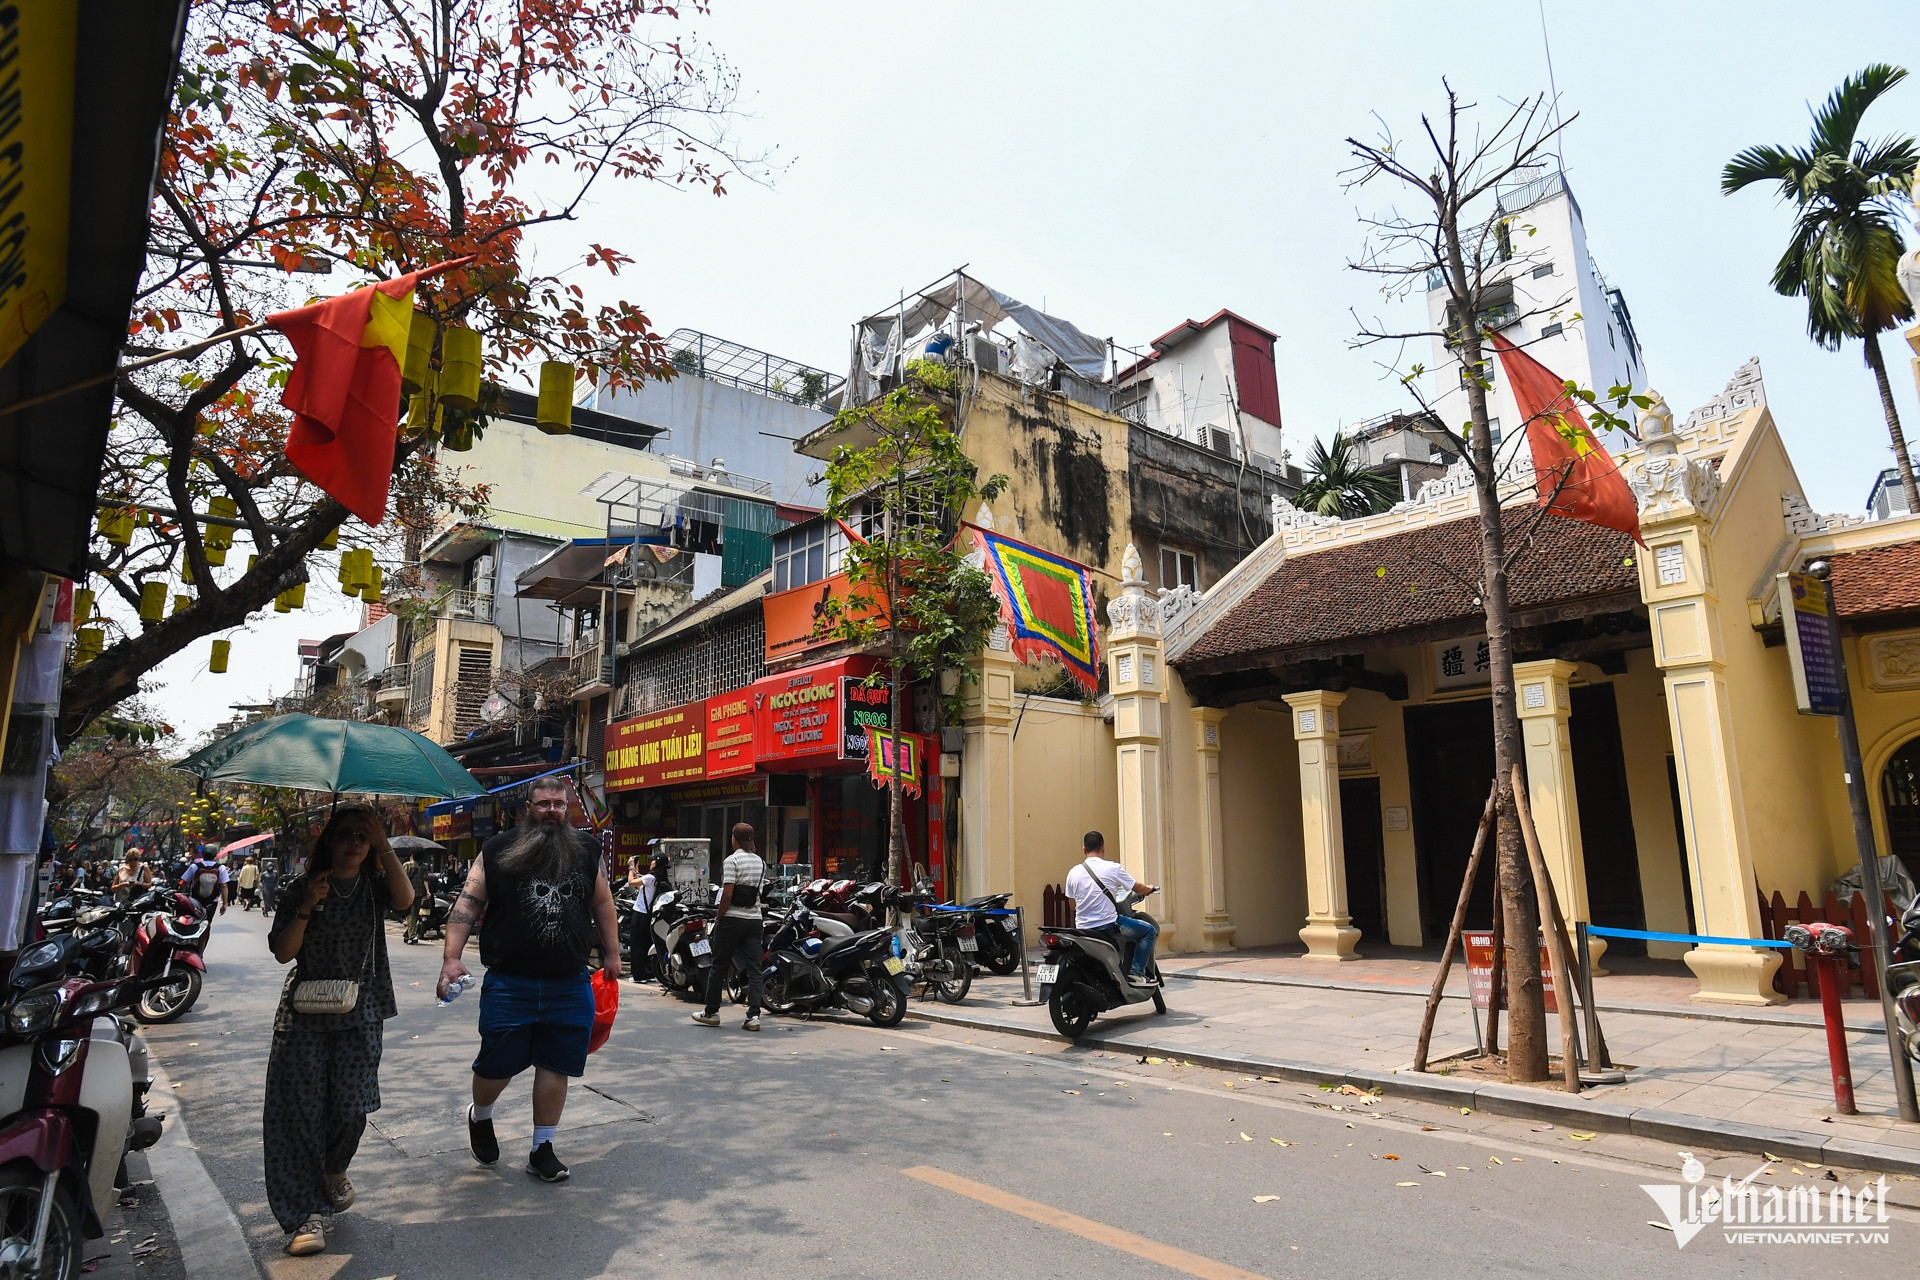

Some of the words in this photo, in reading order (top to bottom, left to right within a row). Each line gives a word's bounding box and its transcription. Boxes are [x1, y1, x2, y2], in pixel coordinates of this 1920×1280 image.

[770, 690, 798, 710] NGỌC
[606, 745, 619, 771] CỬA
[620, 744, 638, 770] HÀNG
[640, 739, 659, 766] VÀNG
[661, 729, 682, 762] TUẤN
[1470, 936, 1490, 945] UBND
